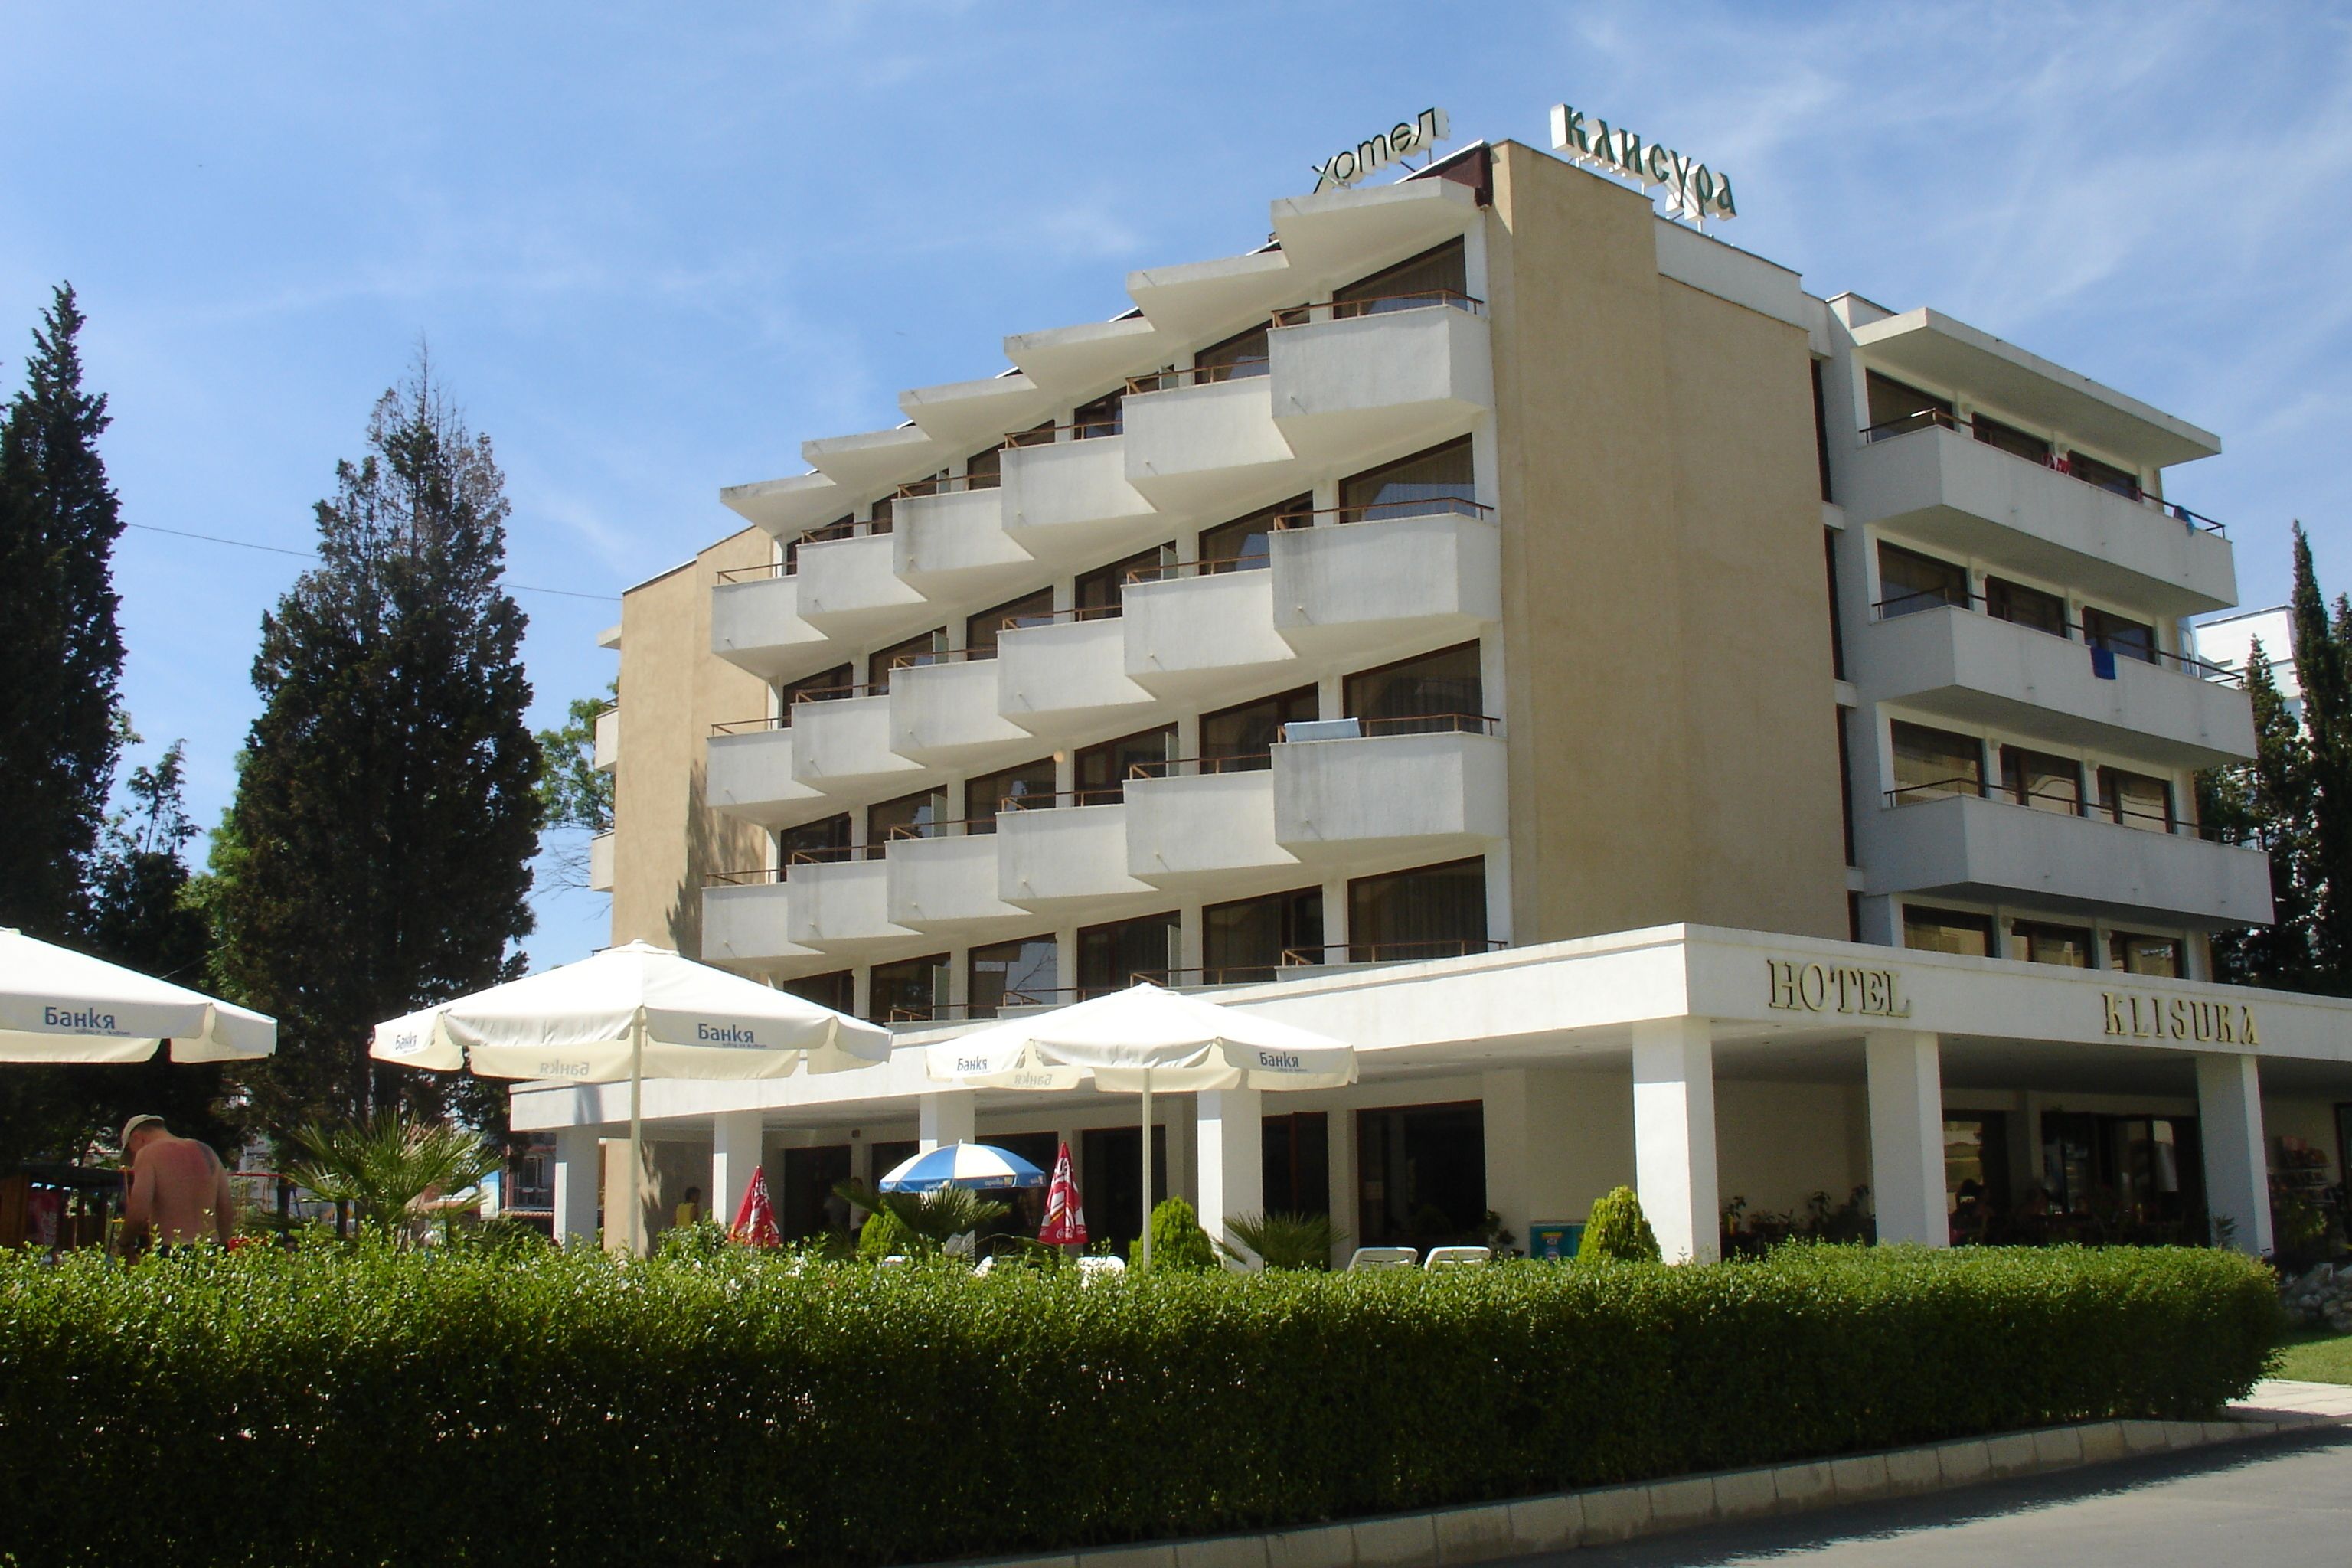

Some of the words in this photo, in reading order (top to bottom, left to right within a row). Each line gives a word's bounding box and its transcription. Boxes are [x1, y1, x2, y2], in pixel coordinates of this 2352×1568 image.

[1767, 959, 1911, 1018] HOTEL
[2101, 992, 2259, 1045] KLISURA
[44, 1006, 116, 1030] Банкя
[697, 1023, 754, 1044] Банкя
[1259, 1051, 1299, 1068] Банкя
